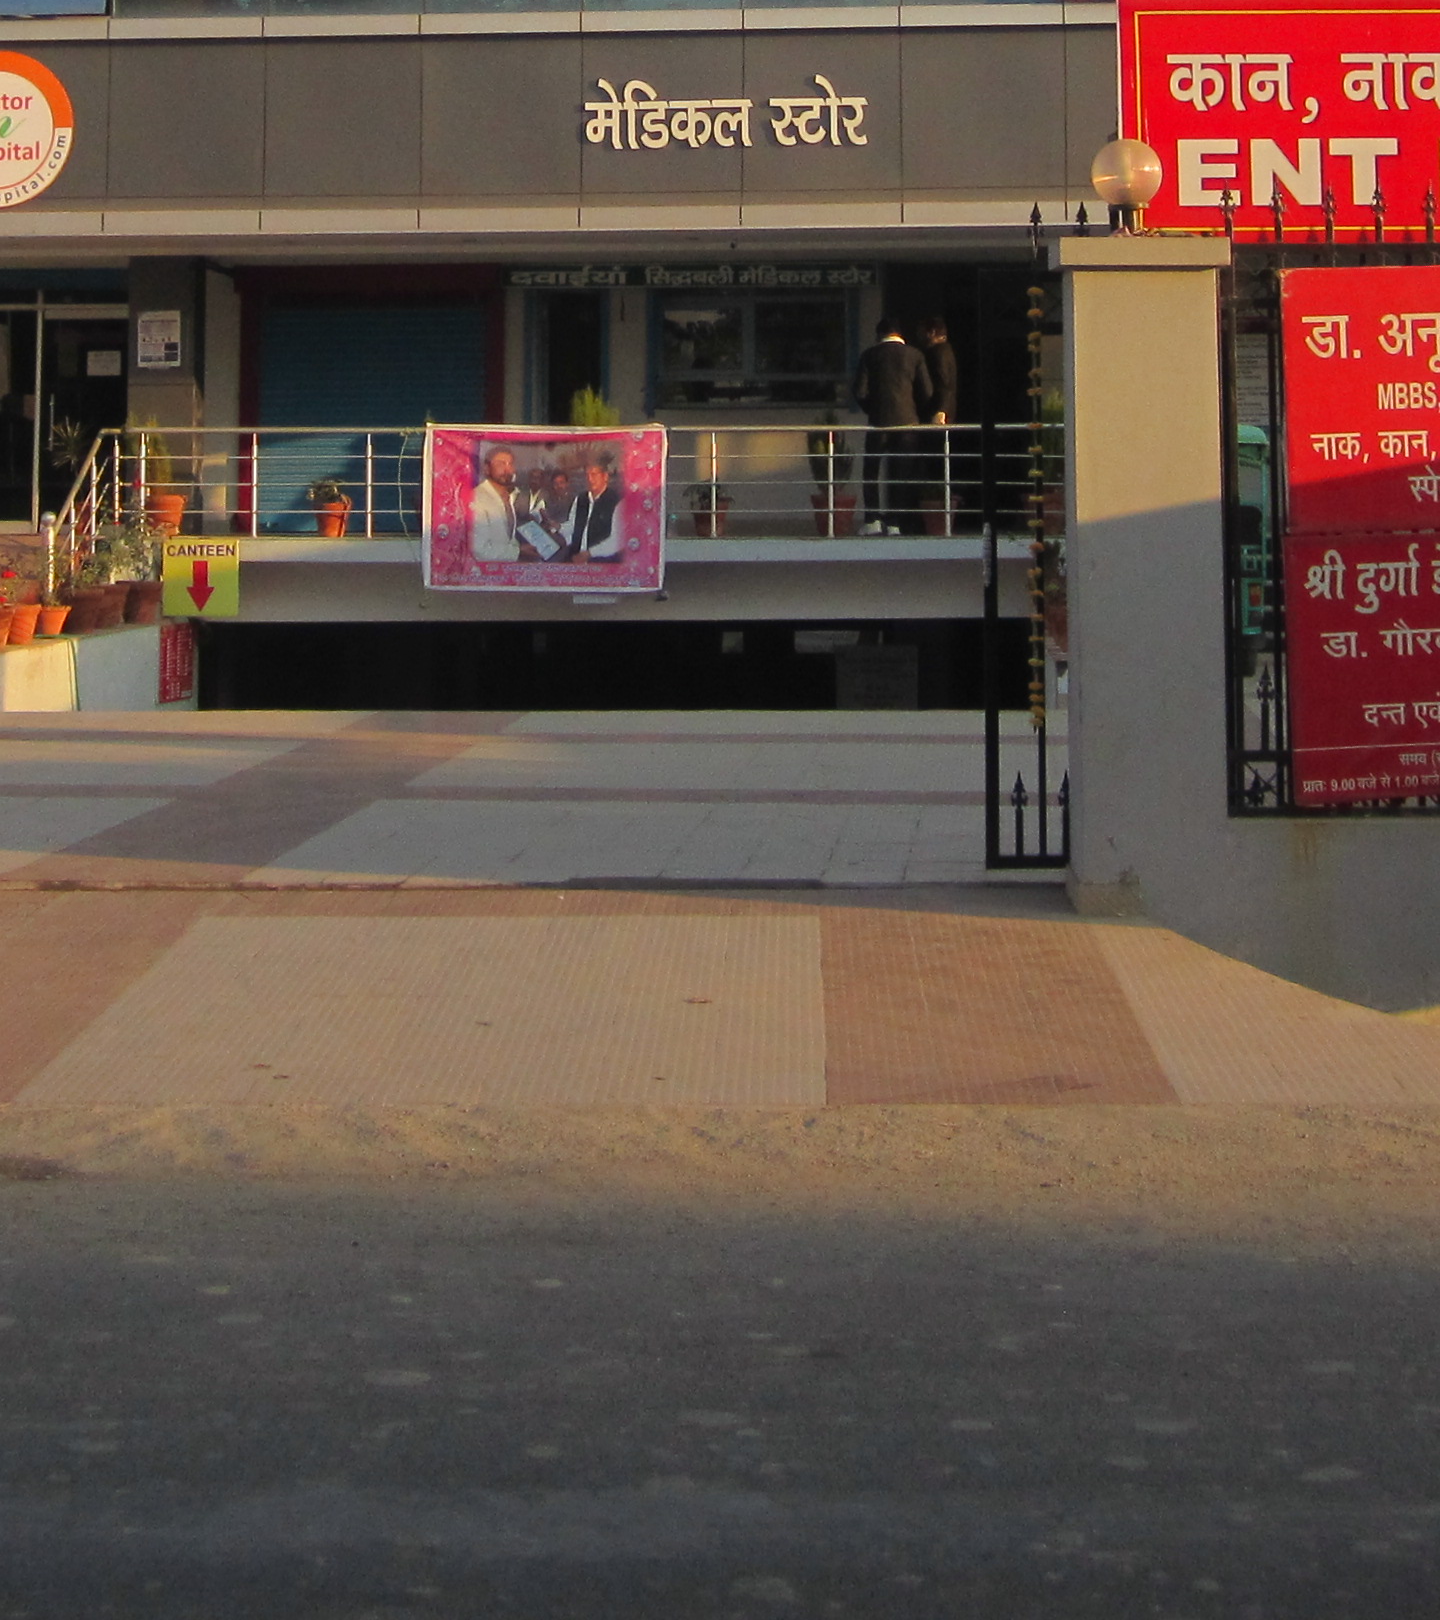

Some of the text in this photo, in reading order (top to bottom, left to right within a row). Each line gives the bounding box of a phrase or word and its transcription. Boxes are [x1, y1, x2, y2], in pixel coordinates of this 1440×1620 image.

[1166, 53, 1319, 123] कान,
[585, 74, 868, 150] मेडिकल स्टोर
[1177, 138, 1398, 206] ENT
[739, 266, 821, 285] मेडिकल
[827, 266, 872, 285] स्टोर
[1302, 314, 1361, 360] डा.
[1310, 432, 1369, 464] नाक,
[1378, 431, 1437, 462] कान,
[167, 545, 235, 557] CANTEEN
[1304, 549, 1346, 600] श्री
[1355, 543, 1419, 614] दुर्गा
[1321, 631, 1368, 658] डा.
[1363, 702, 1405, 727] दन्त
